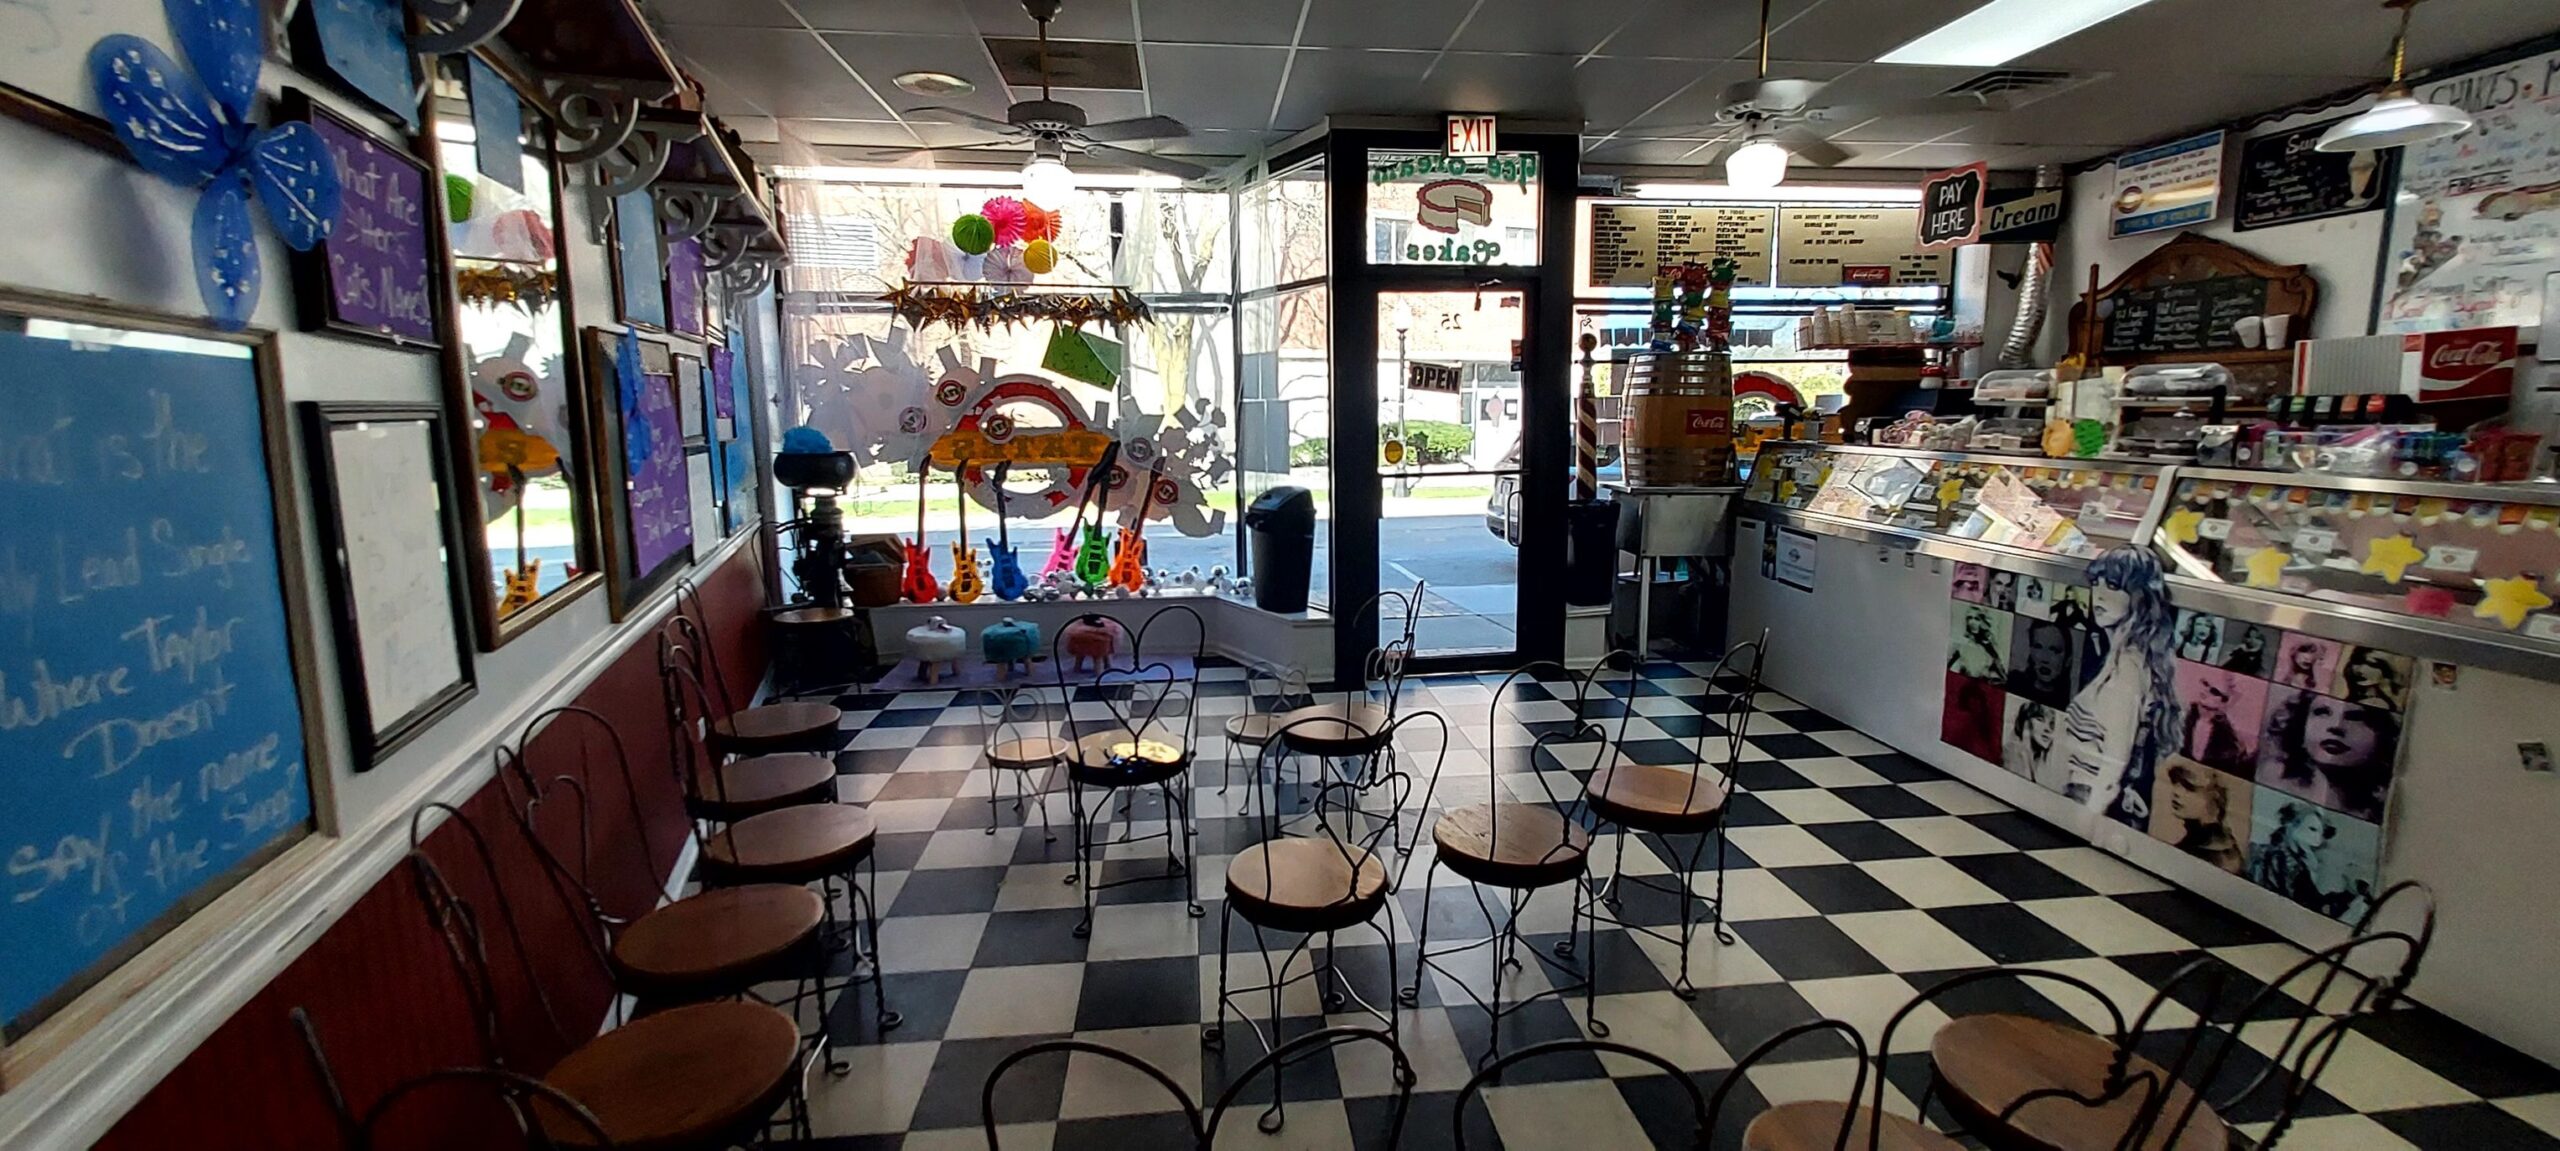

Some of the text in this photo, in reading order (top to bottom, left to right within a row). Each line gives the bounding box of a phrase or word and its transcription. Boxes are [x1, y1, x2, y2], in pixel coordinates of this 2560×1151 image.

[1449, 119, 1493, 153] EXIT
[1939, 180, 1967, 207] PAY
[1931, 207, 1967, 236] HERE
[1990, 203, 2057, 231] Cream
[1410, 365, 1460, 391] OPEN
[131, 776, 184, 839] the
[200, 731, 280, 802] name
[144, 830, 210, 890] the
